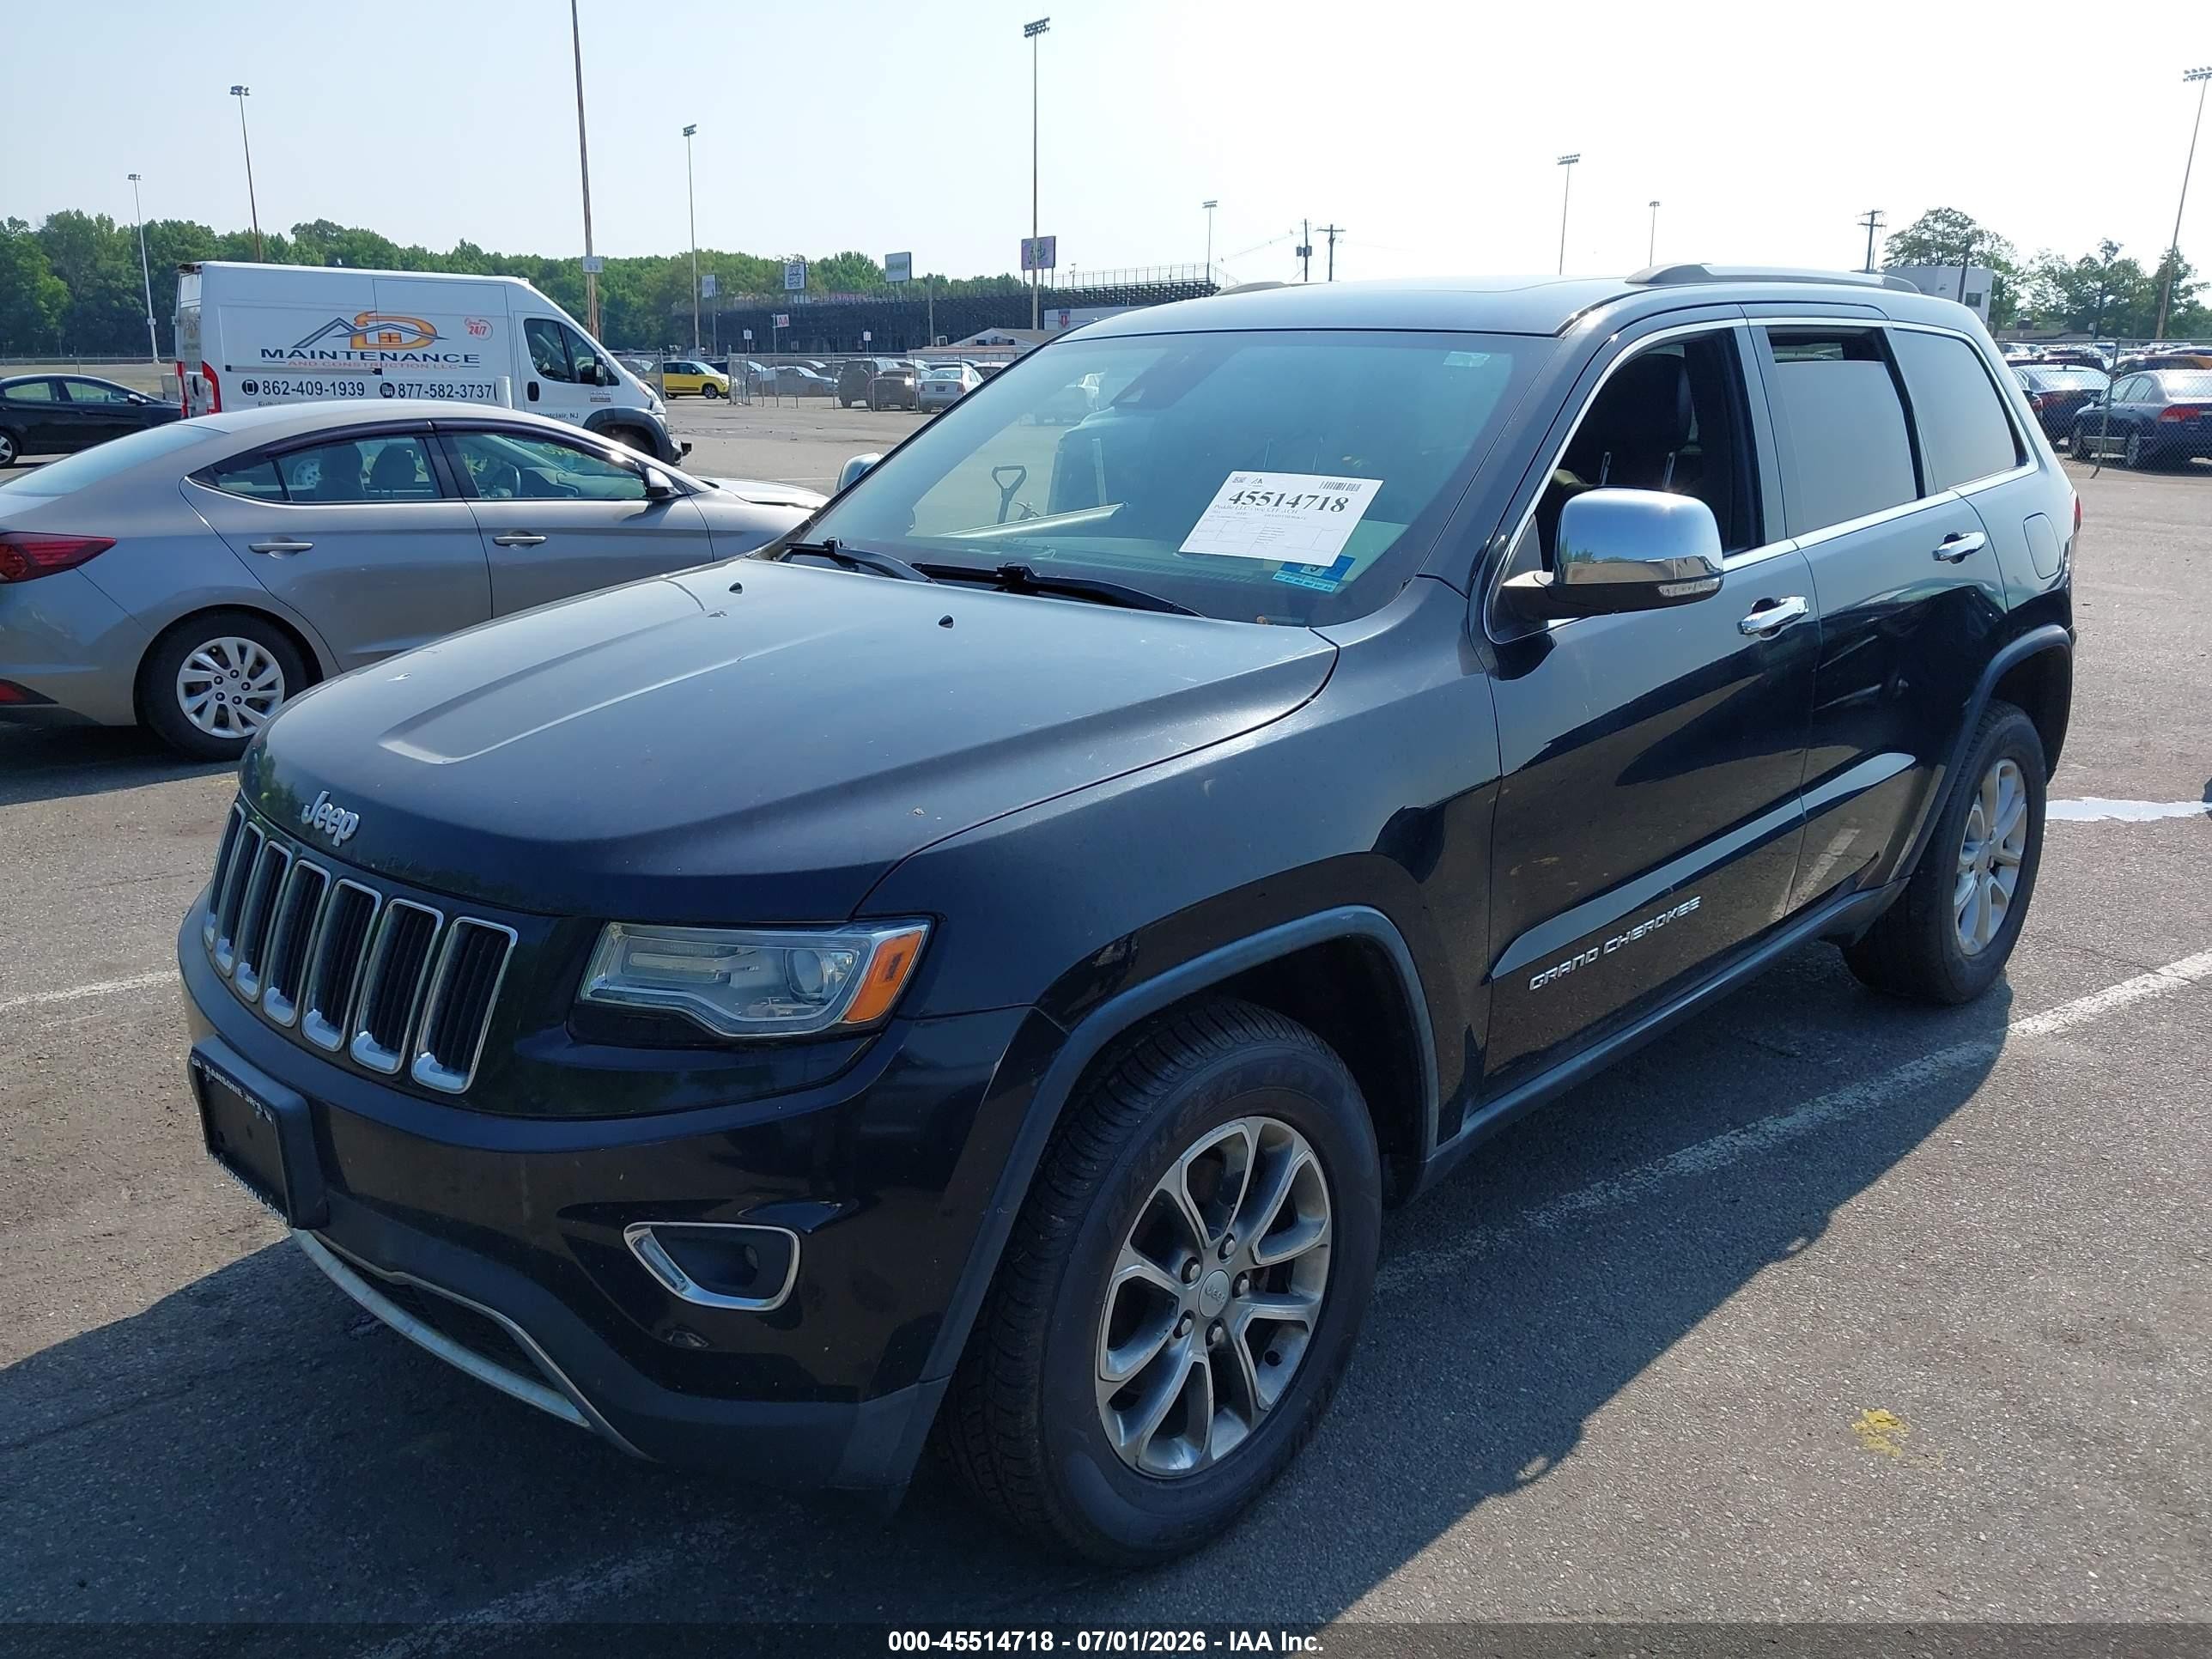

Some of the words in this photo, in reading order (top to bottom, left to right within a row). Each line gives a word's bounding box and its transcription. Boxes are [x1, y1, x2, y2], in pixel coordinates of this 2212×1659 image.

[469, 325, 486, 336] 24/7
[261, 349, 480, 363] MAINTENANCE
[262, 380, 365, 396] 862-409-1939
[398, 383, 492, 398] 877-582-3737
[1229, 490, 1349, 512] 45514718
[301, 790, 360, 848] Jeep
[1528, 947, 1599, 991] GRAND
[1603, 896, 1702, 955] CHEROKEE
[1205, 1285, 1225, 1306] Jeep
